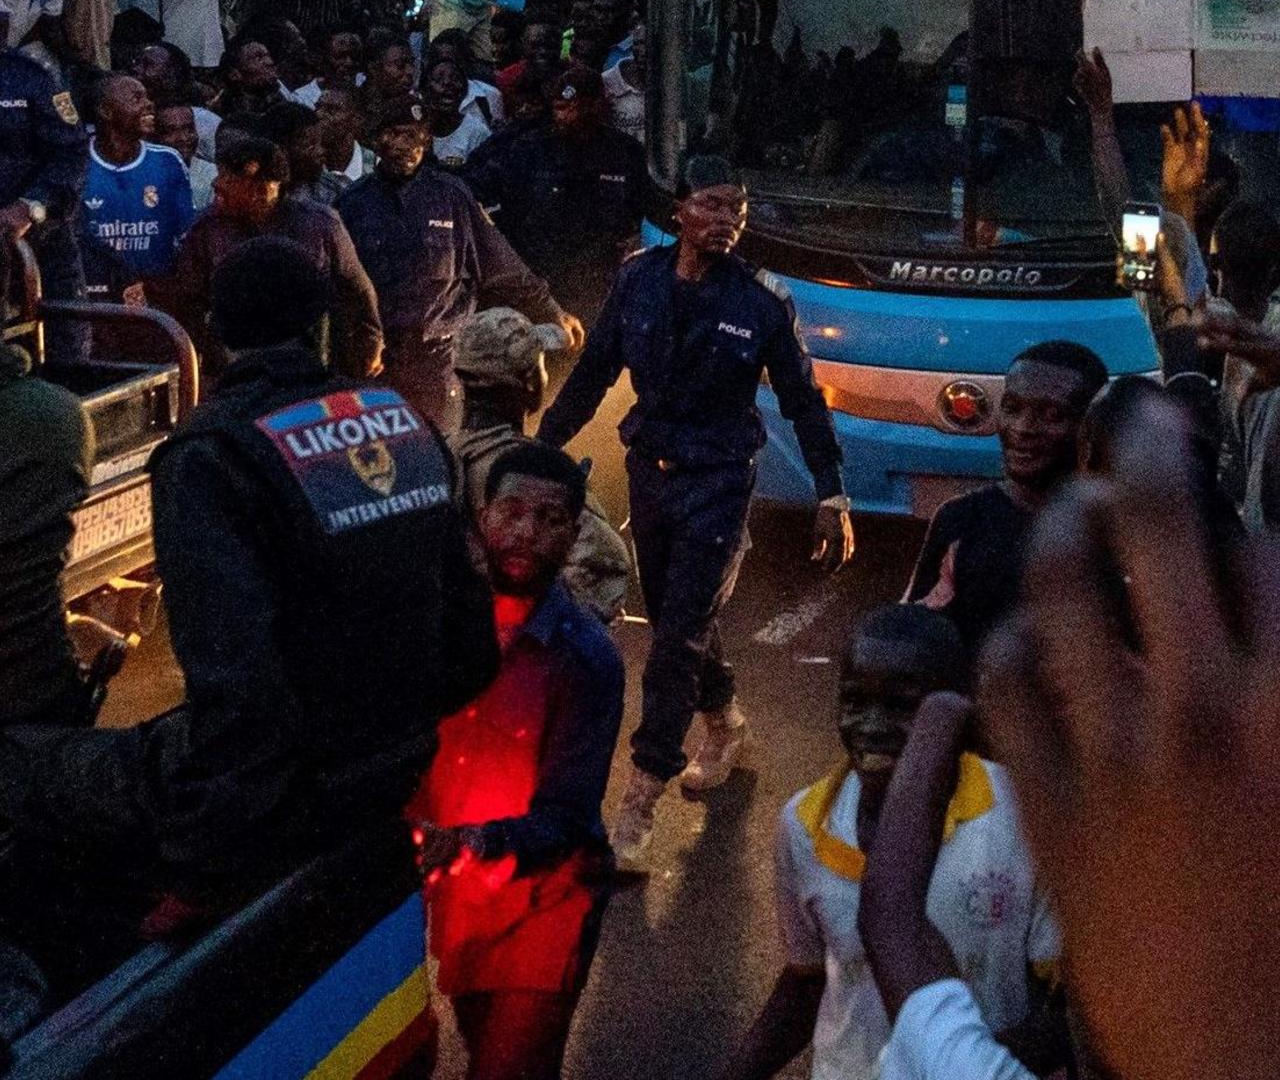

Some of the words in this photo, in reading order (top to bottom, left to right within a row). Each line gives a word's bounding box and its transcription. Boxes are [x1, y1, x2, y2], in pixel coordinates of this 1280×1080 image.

[889, 261, 1041, 285] Marcopolo
[718, 321, 752, 340] POLICE
[286, 407, 419, 458] LIKONZI
[328, 484, 449, 529] INTERVENTION
